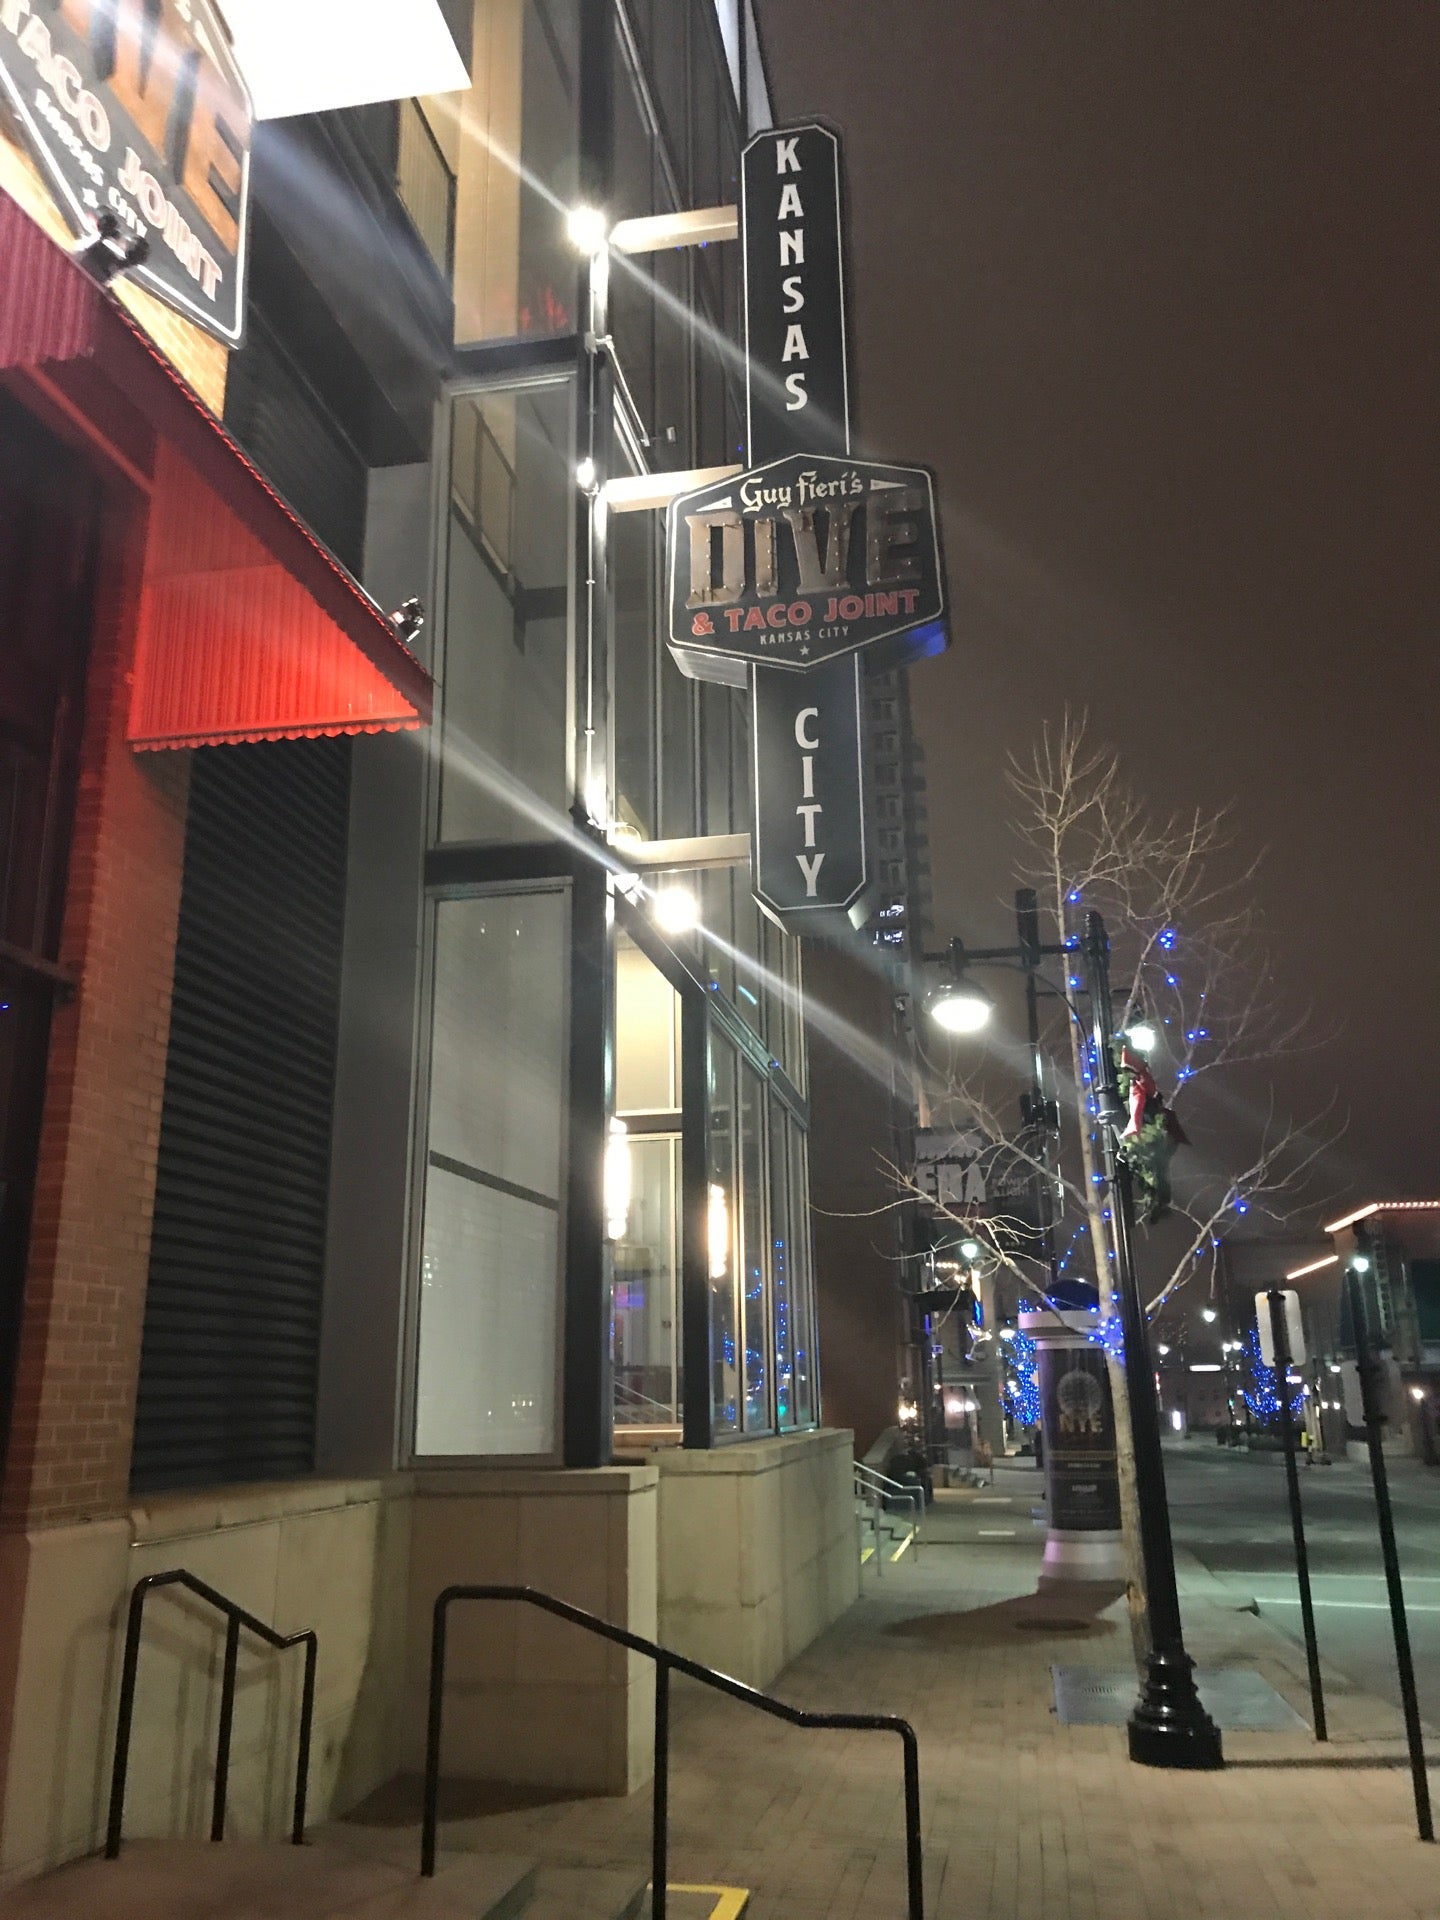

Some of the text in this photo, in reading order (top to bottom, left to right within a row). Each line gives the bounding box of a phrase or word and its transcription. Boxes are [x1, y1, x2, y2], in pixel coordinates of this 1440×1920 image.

[117, 146, 223, 302] JOINT
[776, 136, 810, 412] KANSAS
[684, 488, 924, 609] DIVE
[739, 477, 792, 513] Guy
[691, 589, 920, 636] & TACO JOINT
[760, 625, 850, 645] KANSAS CITY
[795, 707, 826, 897] CITY
